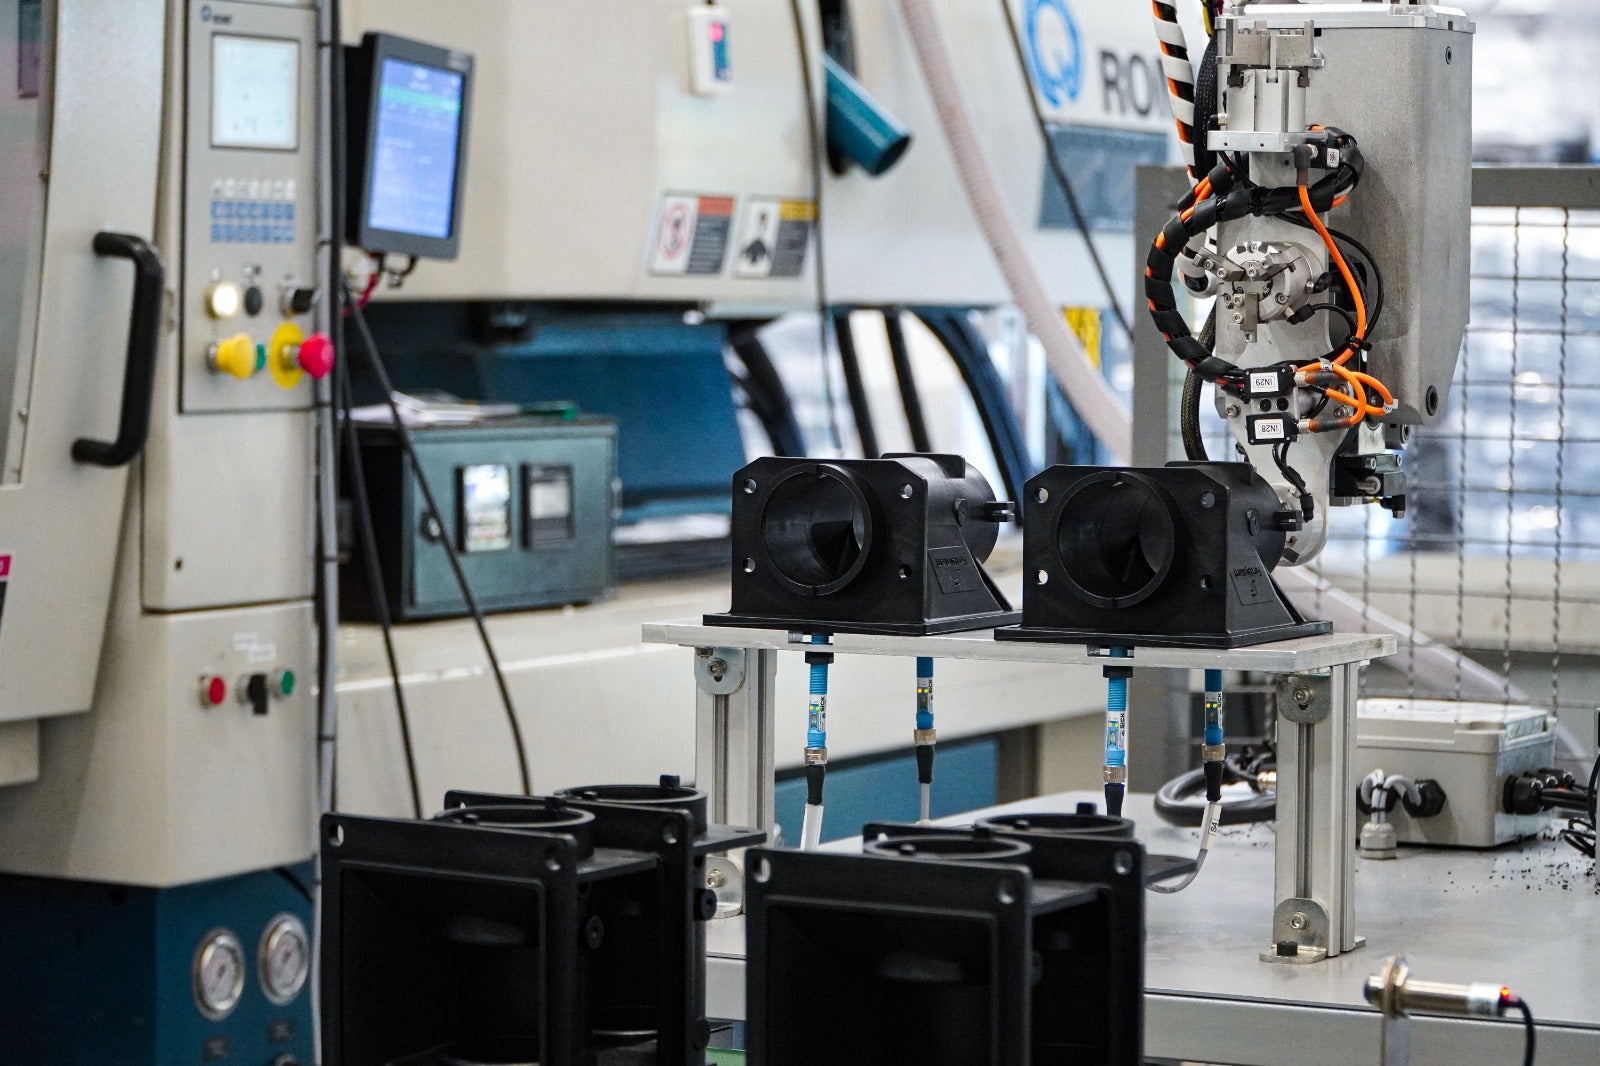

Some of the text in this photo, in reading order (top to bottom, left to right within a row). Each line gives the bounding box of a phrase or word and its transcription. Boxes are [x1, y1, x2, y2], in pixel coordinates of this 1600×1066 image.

[1099, 50, 1166, 116] RO
[1255, 378, 1273, 387] IN29
[1261, 424, 1278, 434] IN28
[1210, 822, 1218, 833] S4
